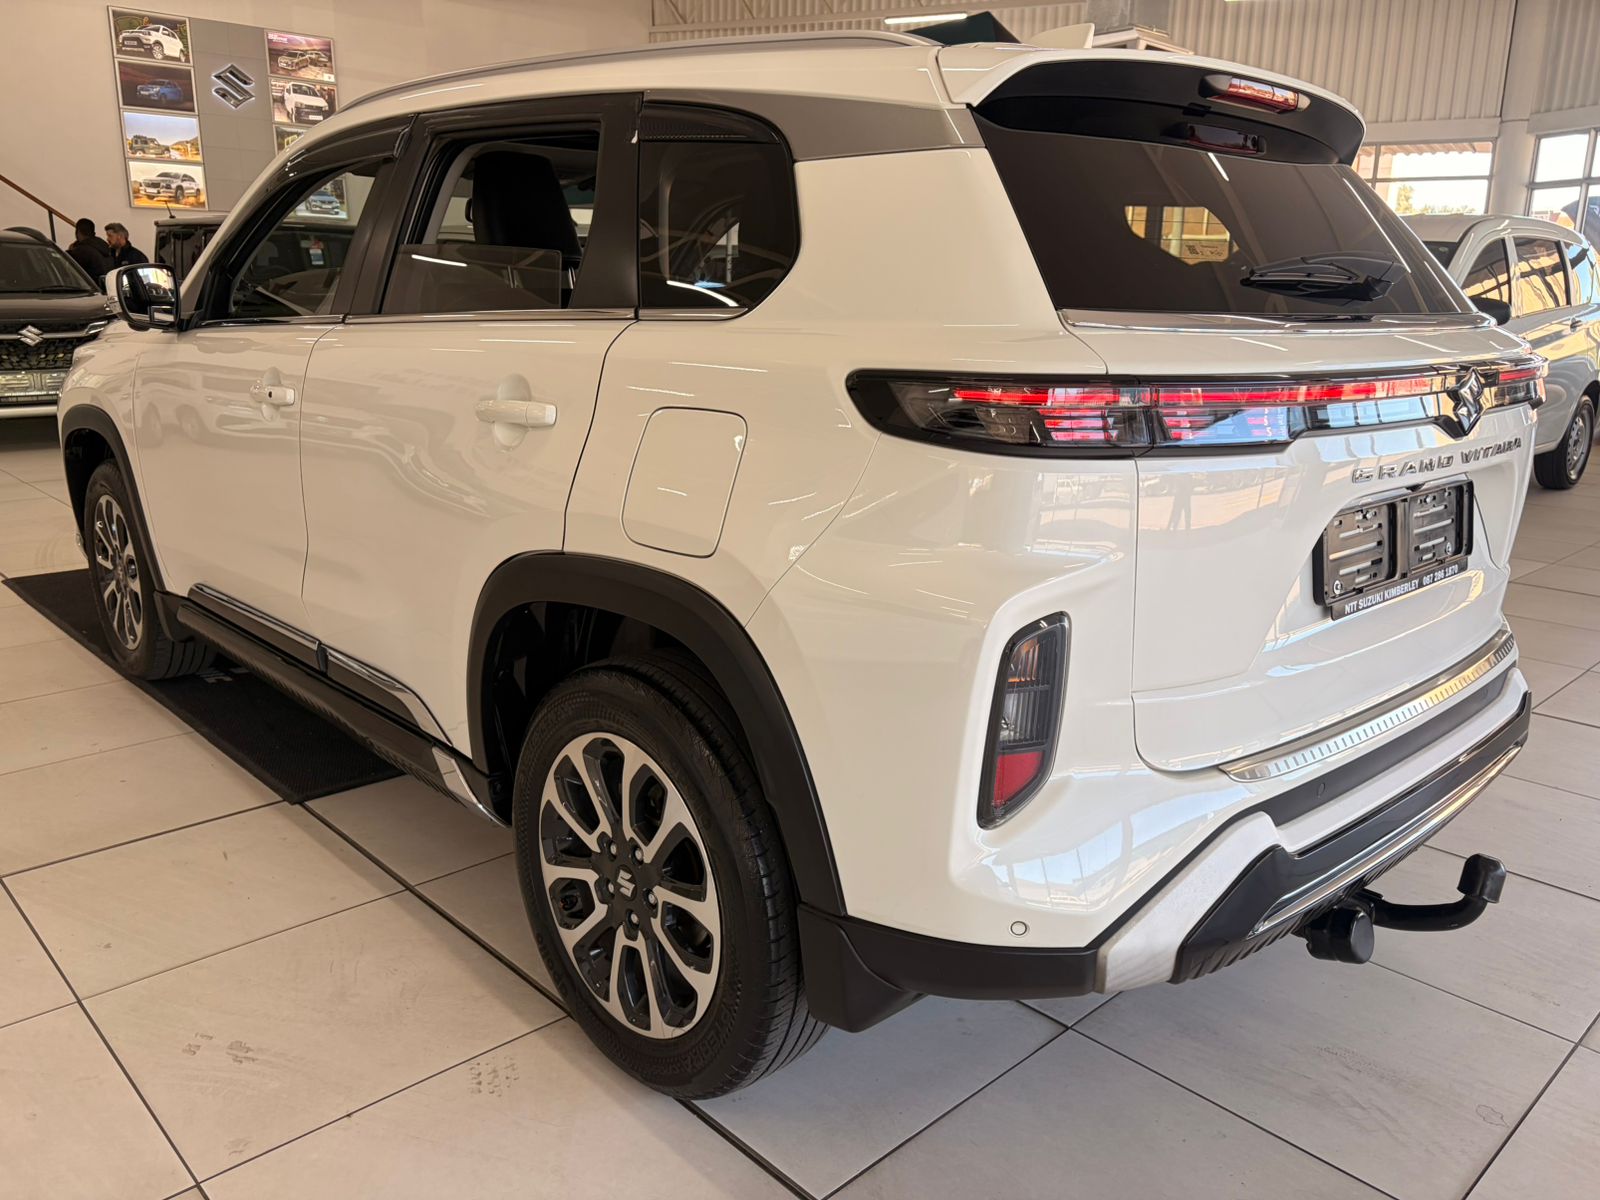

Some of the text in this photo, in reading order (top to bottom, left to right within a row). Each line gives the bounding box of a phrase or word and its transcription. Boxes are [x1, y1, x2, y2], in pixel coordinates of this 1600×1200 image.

[1352, 437, 1522, 484] GRAND VITARA
[1344, 601, 1358, 615] NTT
[1358, 591, 1384, 610] SUZUKI
[1384, 578, 1420, 601] KIMBERLEY
